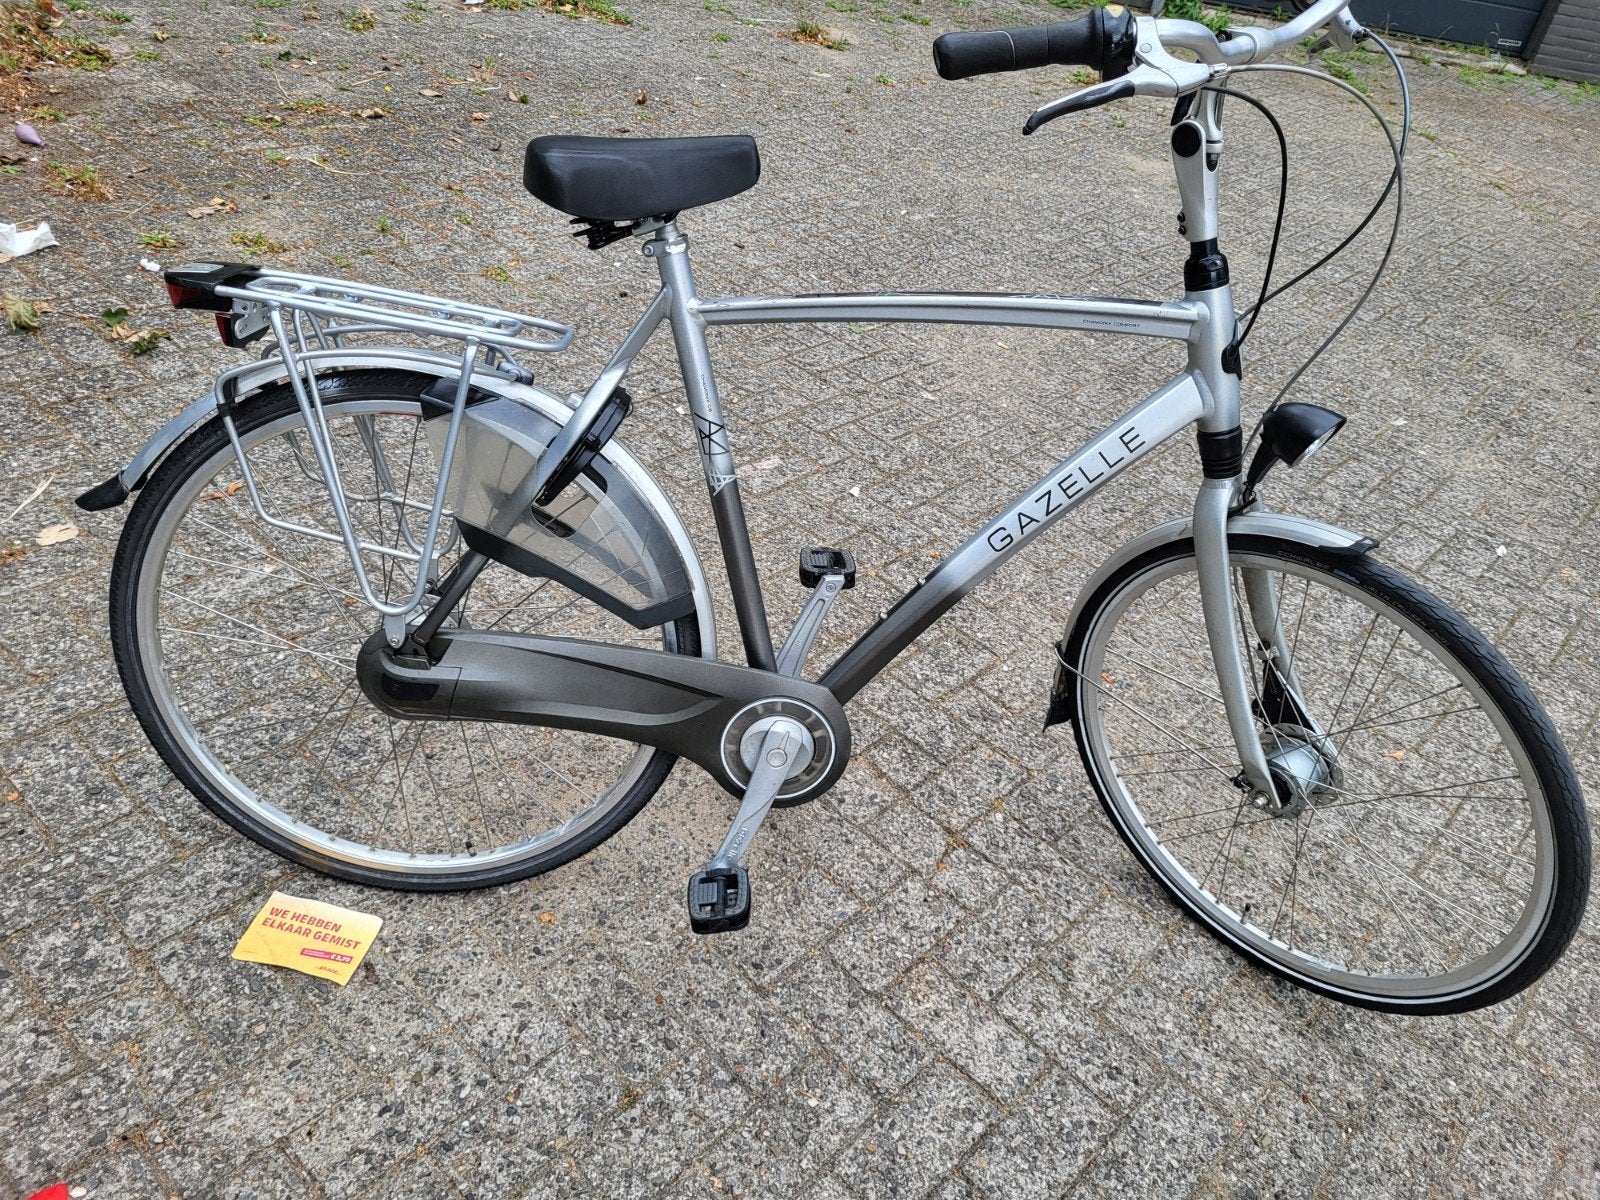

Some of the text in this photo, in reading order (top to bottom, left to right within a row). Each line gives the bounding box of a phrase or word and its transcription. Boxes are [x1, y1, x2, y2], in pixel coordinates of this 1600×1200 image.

[987, 426, 1146, 552] GAZELLE
[262, 917, 361, 950] ELKAAR GEMIST
[269, 907, 342, 932] WE HEBBEN
